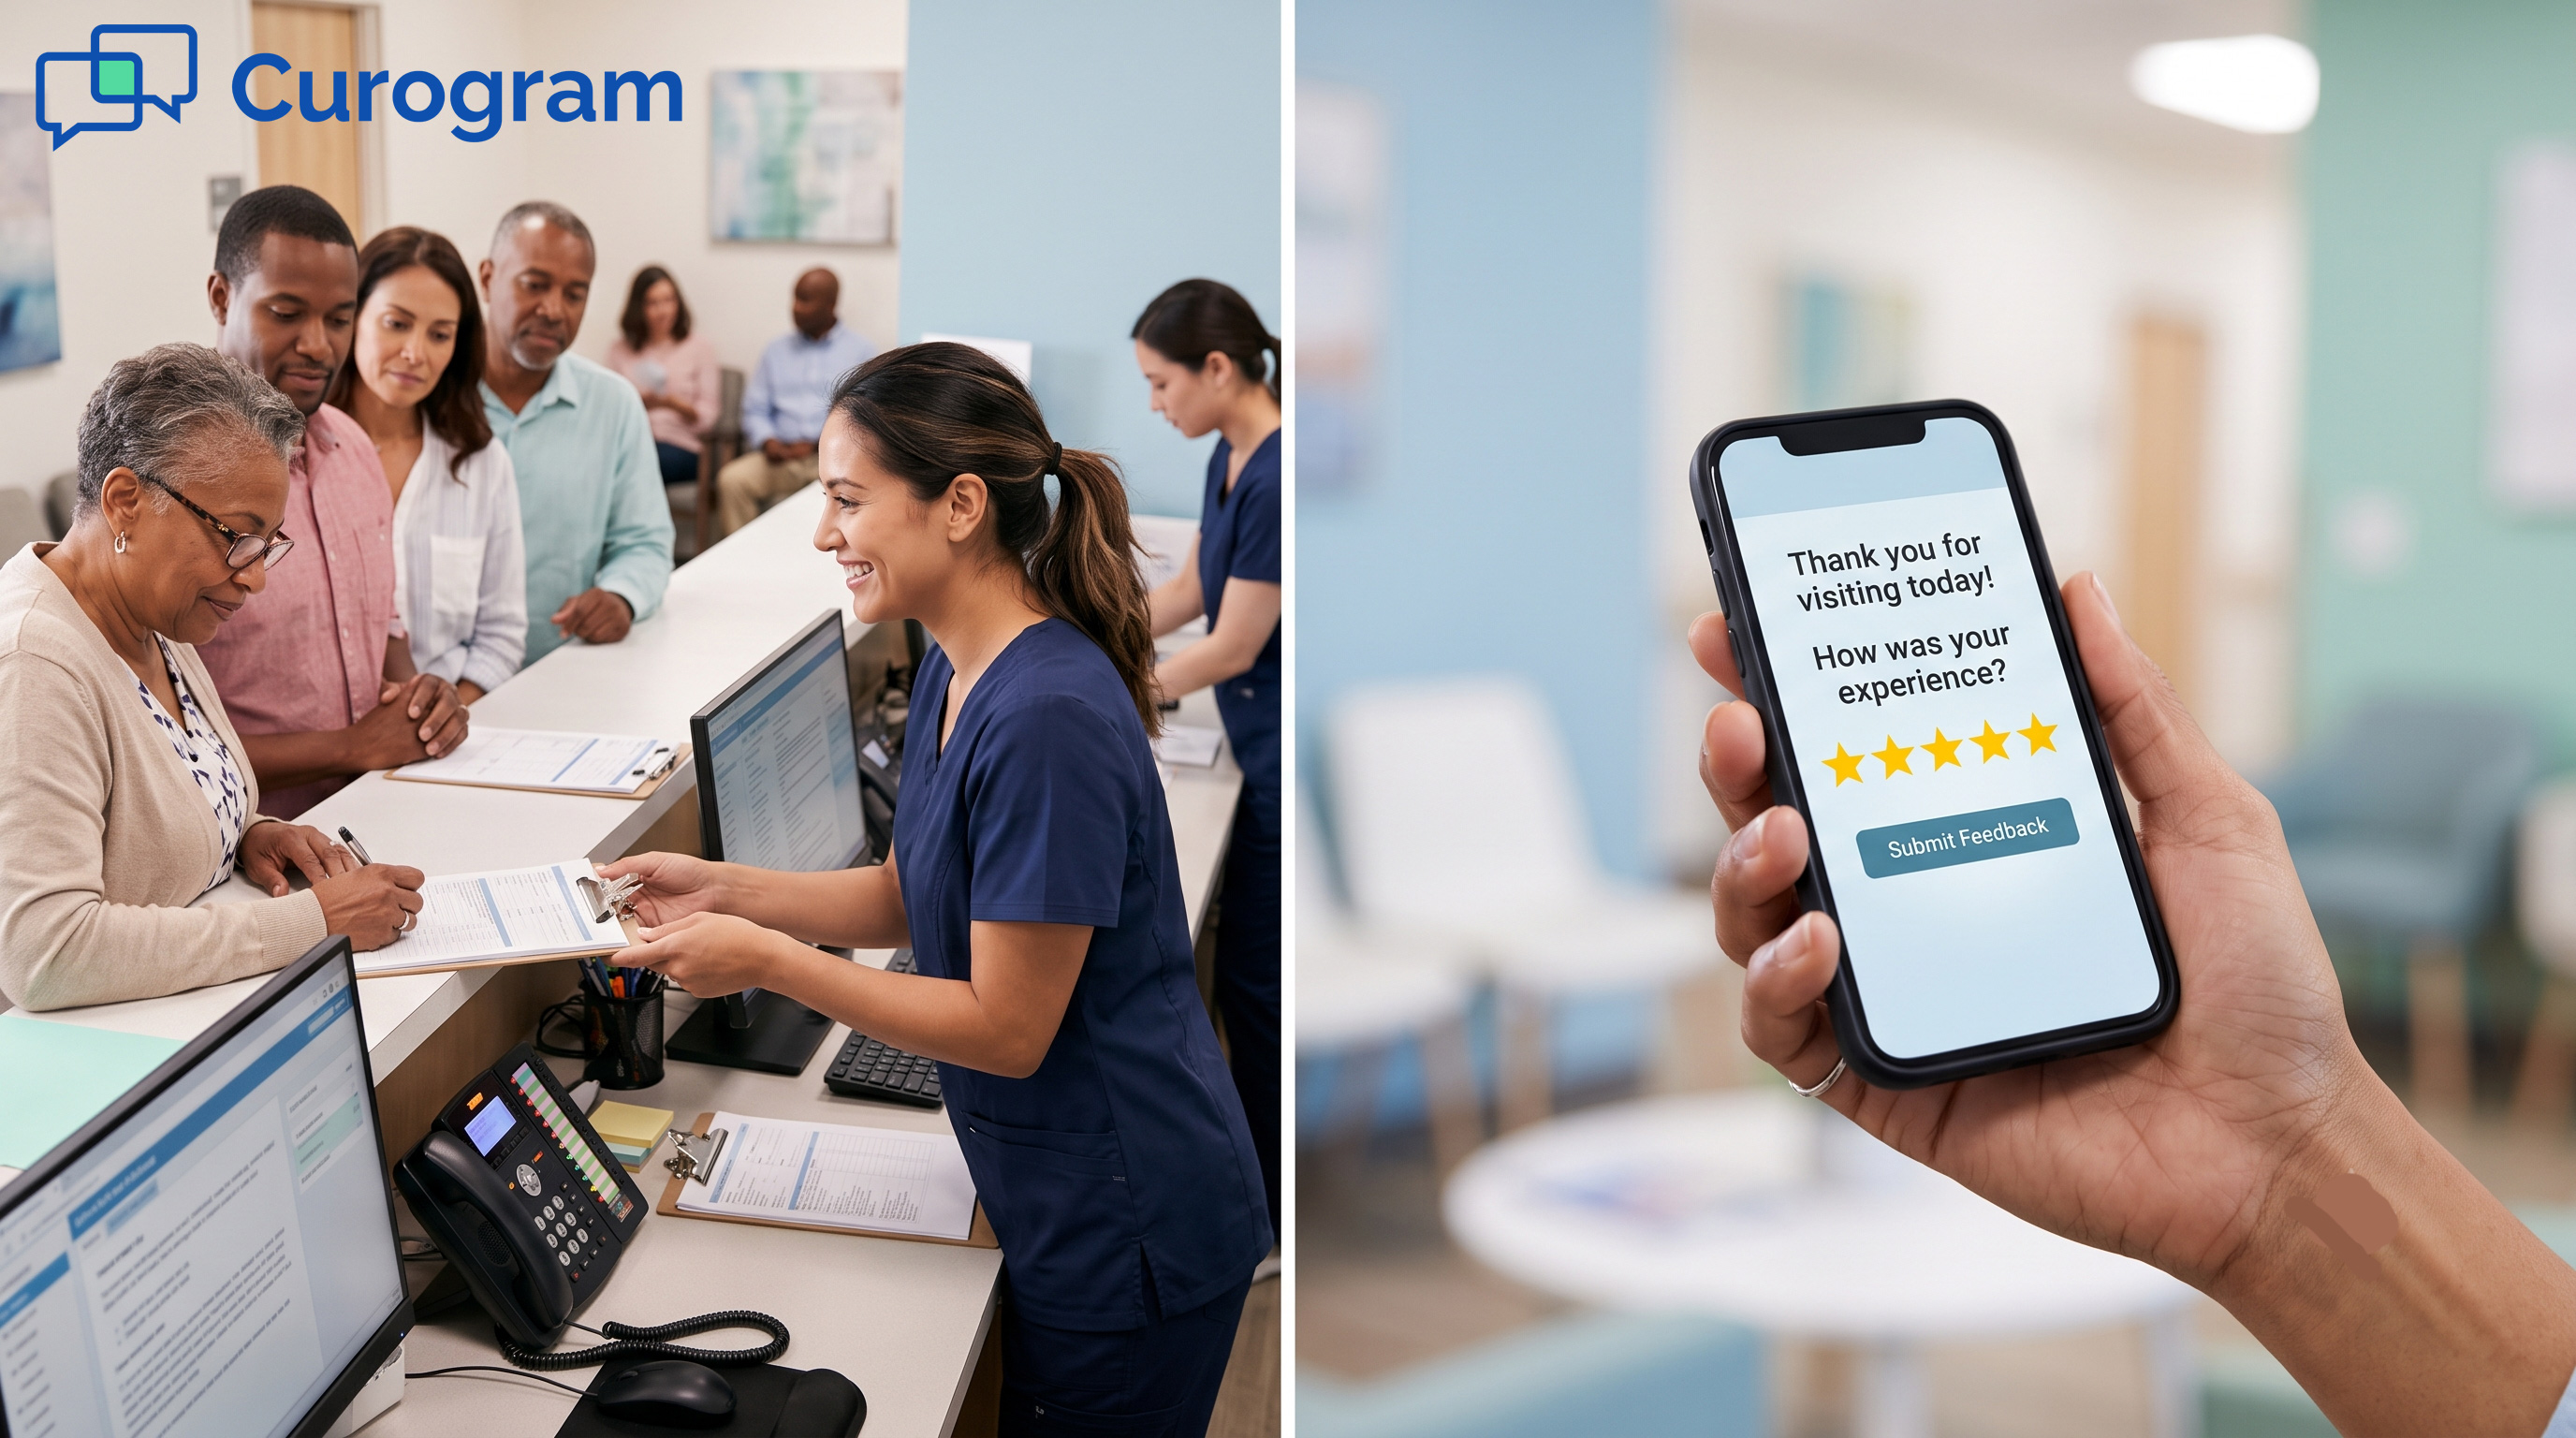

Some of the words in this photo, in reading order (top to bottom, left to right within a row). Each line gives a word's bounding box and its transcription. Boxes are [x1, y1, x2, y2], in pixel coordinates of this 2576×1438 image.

[1787, 543, 1880, 577] Thank
[1883, 541, 1937, 572] you
[1941, 532, 1981, 558] for
[1796, 580, 1902, 612] visiting
[1906, 565, 1995, 598] today!
[1812, 644, 1877, 670] How
[1884, 636, 1943, 661] was
[1948, 624, 2010, 659] your
[1838, 658, 2006, 707] experience?
[1888, 832, 1956, 858] Submit
[1958, 816, 2050, 847] Feedback
